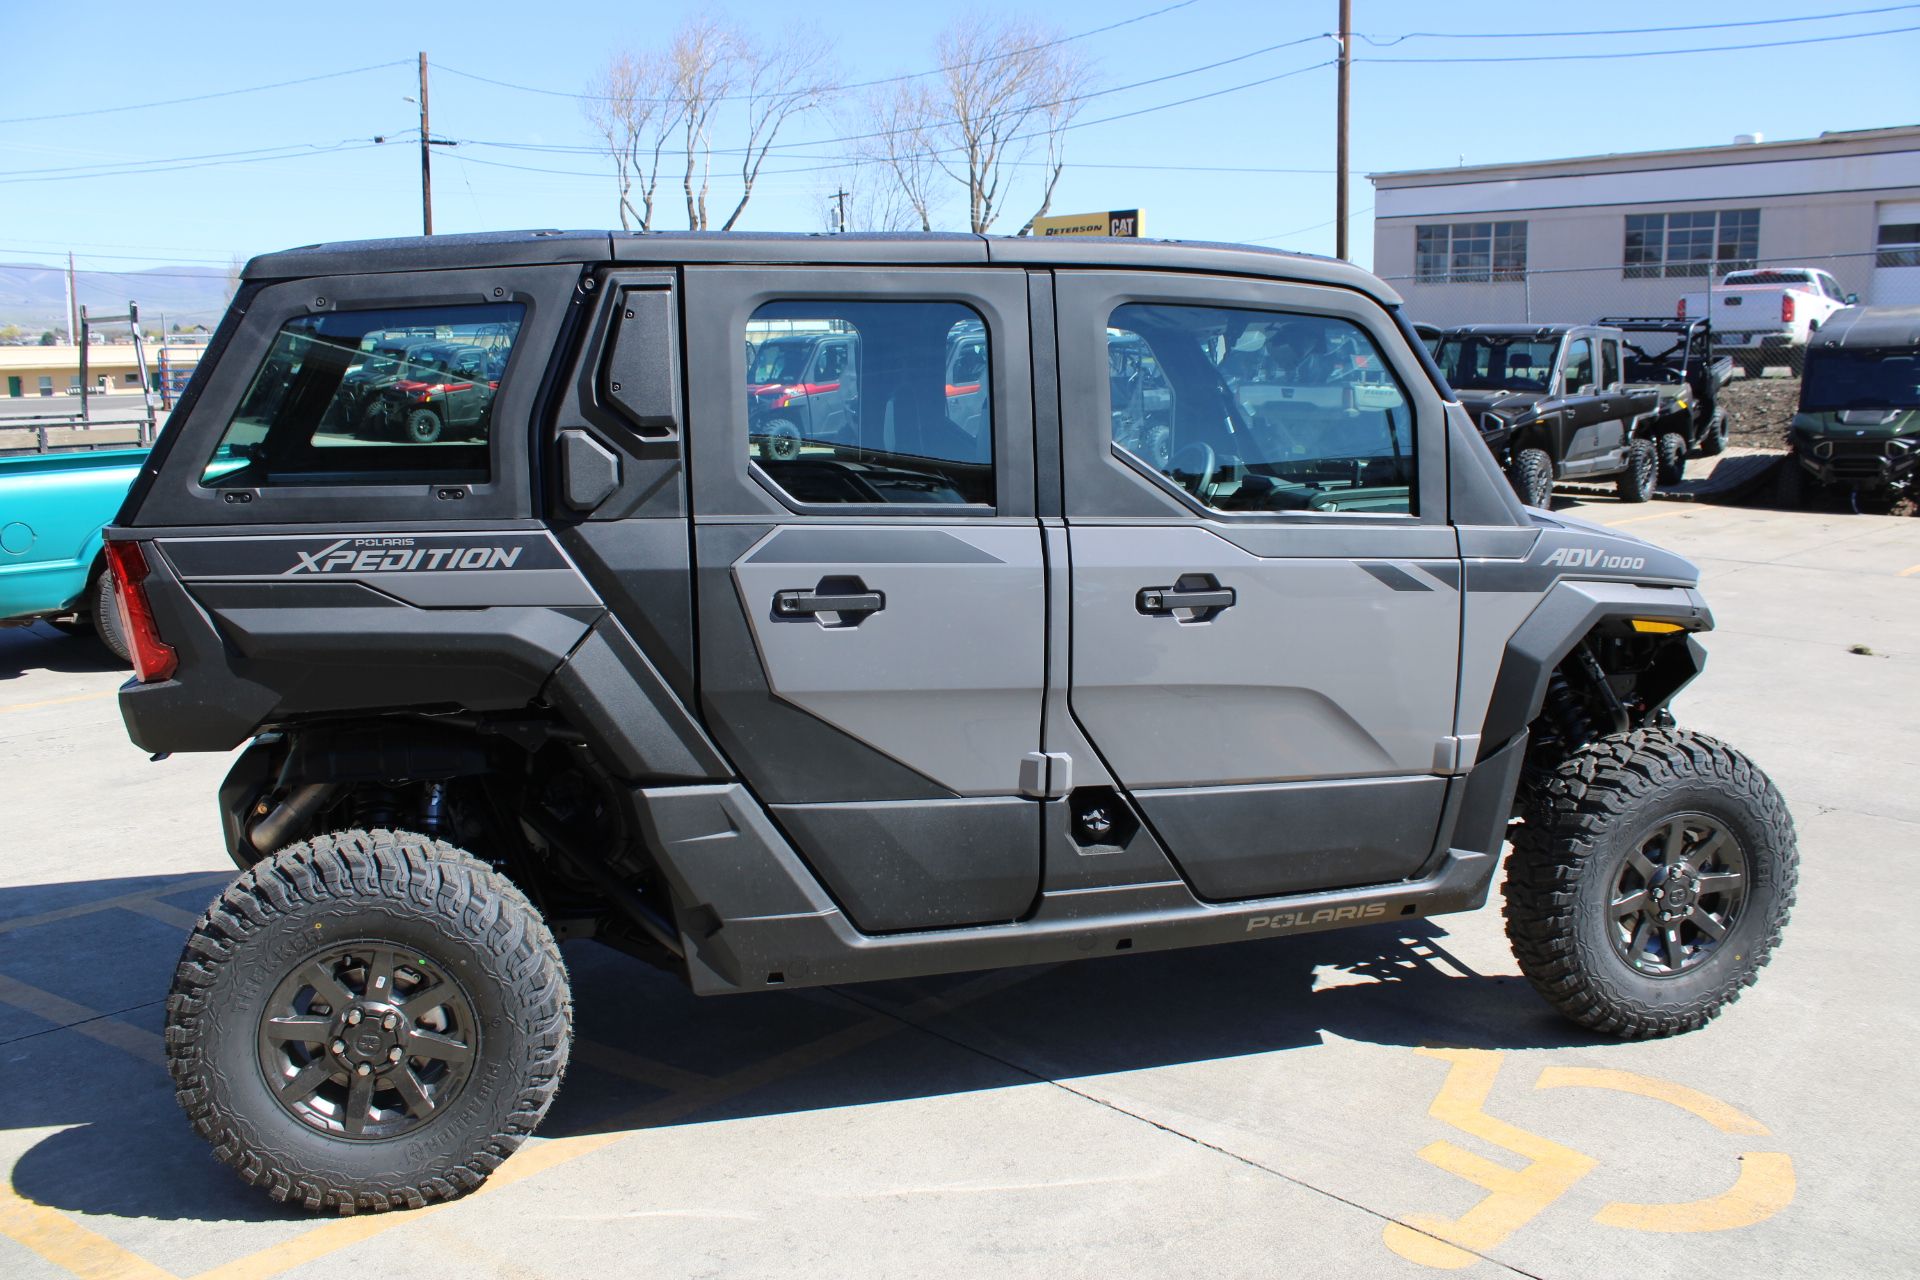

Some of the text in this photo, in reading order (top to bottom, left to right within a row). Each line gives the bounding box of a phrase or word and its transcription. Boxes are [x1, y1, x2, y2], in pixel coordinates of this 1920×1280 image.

[1045, 218, 1134, 237] PETERSON CAT
[355, 538, 415, 547] POLARIS
[281, 539, 523, 575] XPEDITION
[1541, 548, 1645, 570] ADV 1000
[1246, 902, 1386, 932] POLARIS
